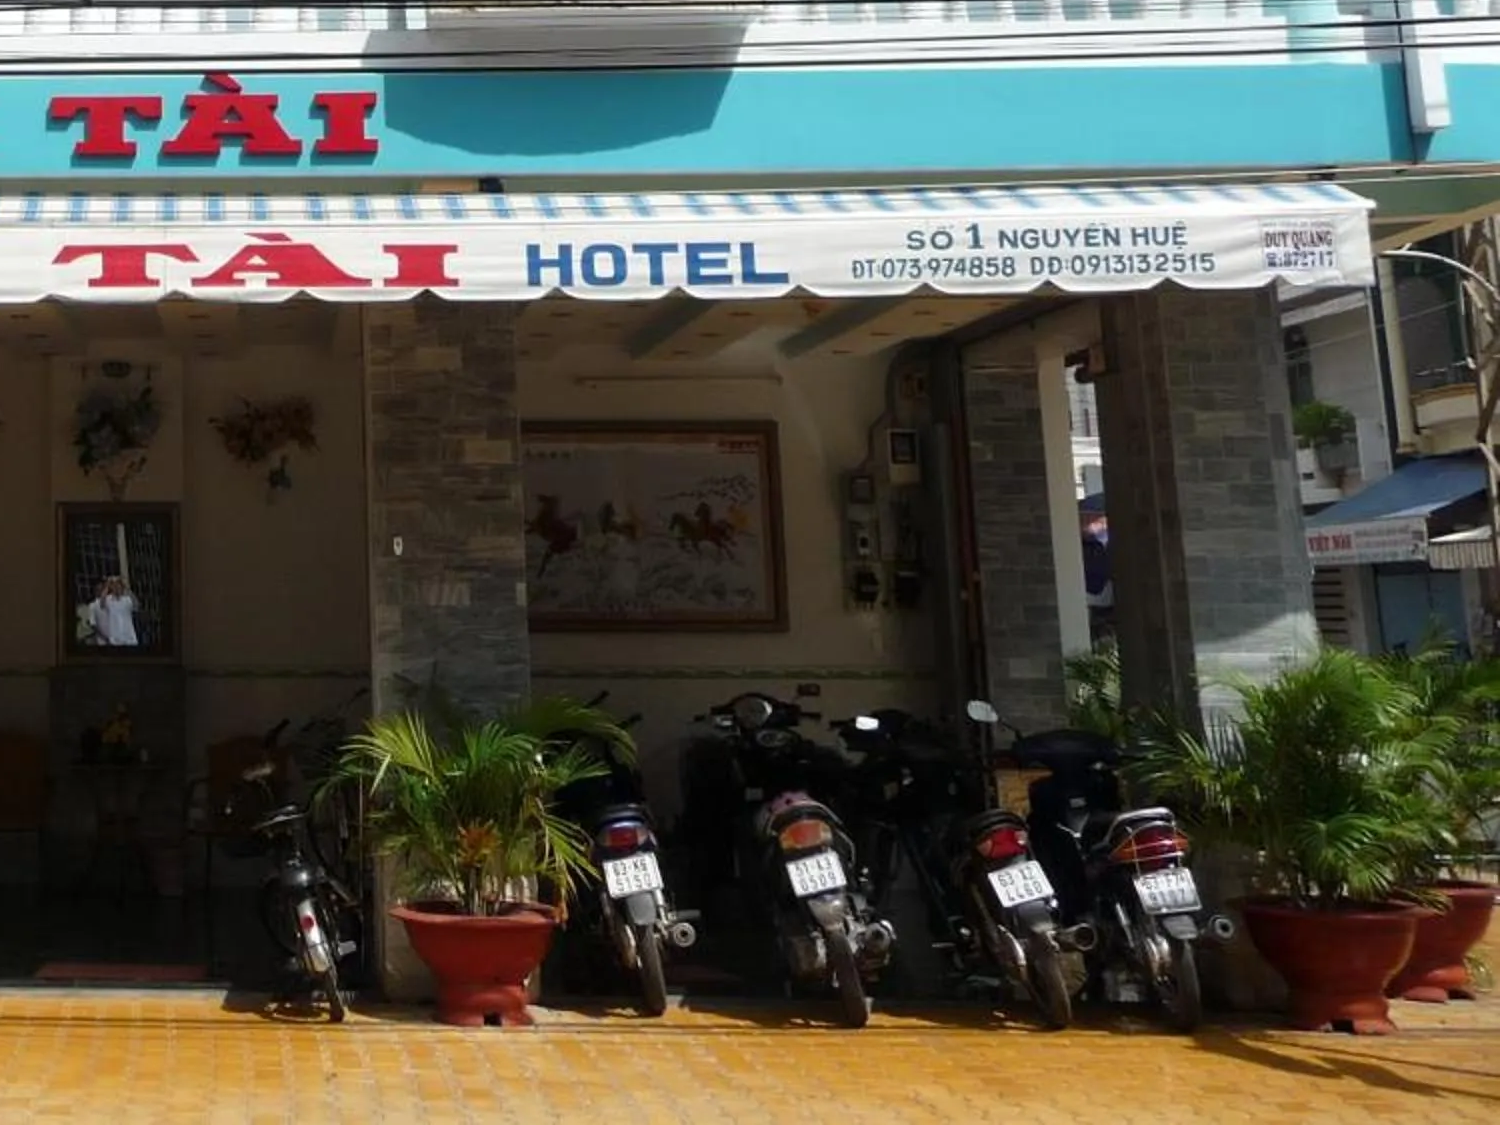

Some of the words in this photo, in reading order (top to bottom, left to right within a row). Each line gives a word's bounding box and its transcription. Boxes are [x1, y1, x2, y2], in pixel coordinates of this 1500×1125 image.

[48, 73, 378, 157] TÀI
[965, 222, 984, 250] 1
[1130, 221, 1188, 250] HUỆ
[1264, 231, 1288, 248] DUY
[1291, 230, 1333, 250] QUANG
[52, 232, 460, 289] TÀI
[525, 242, 790, 287] HOTEL
